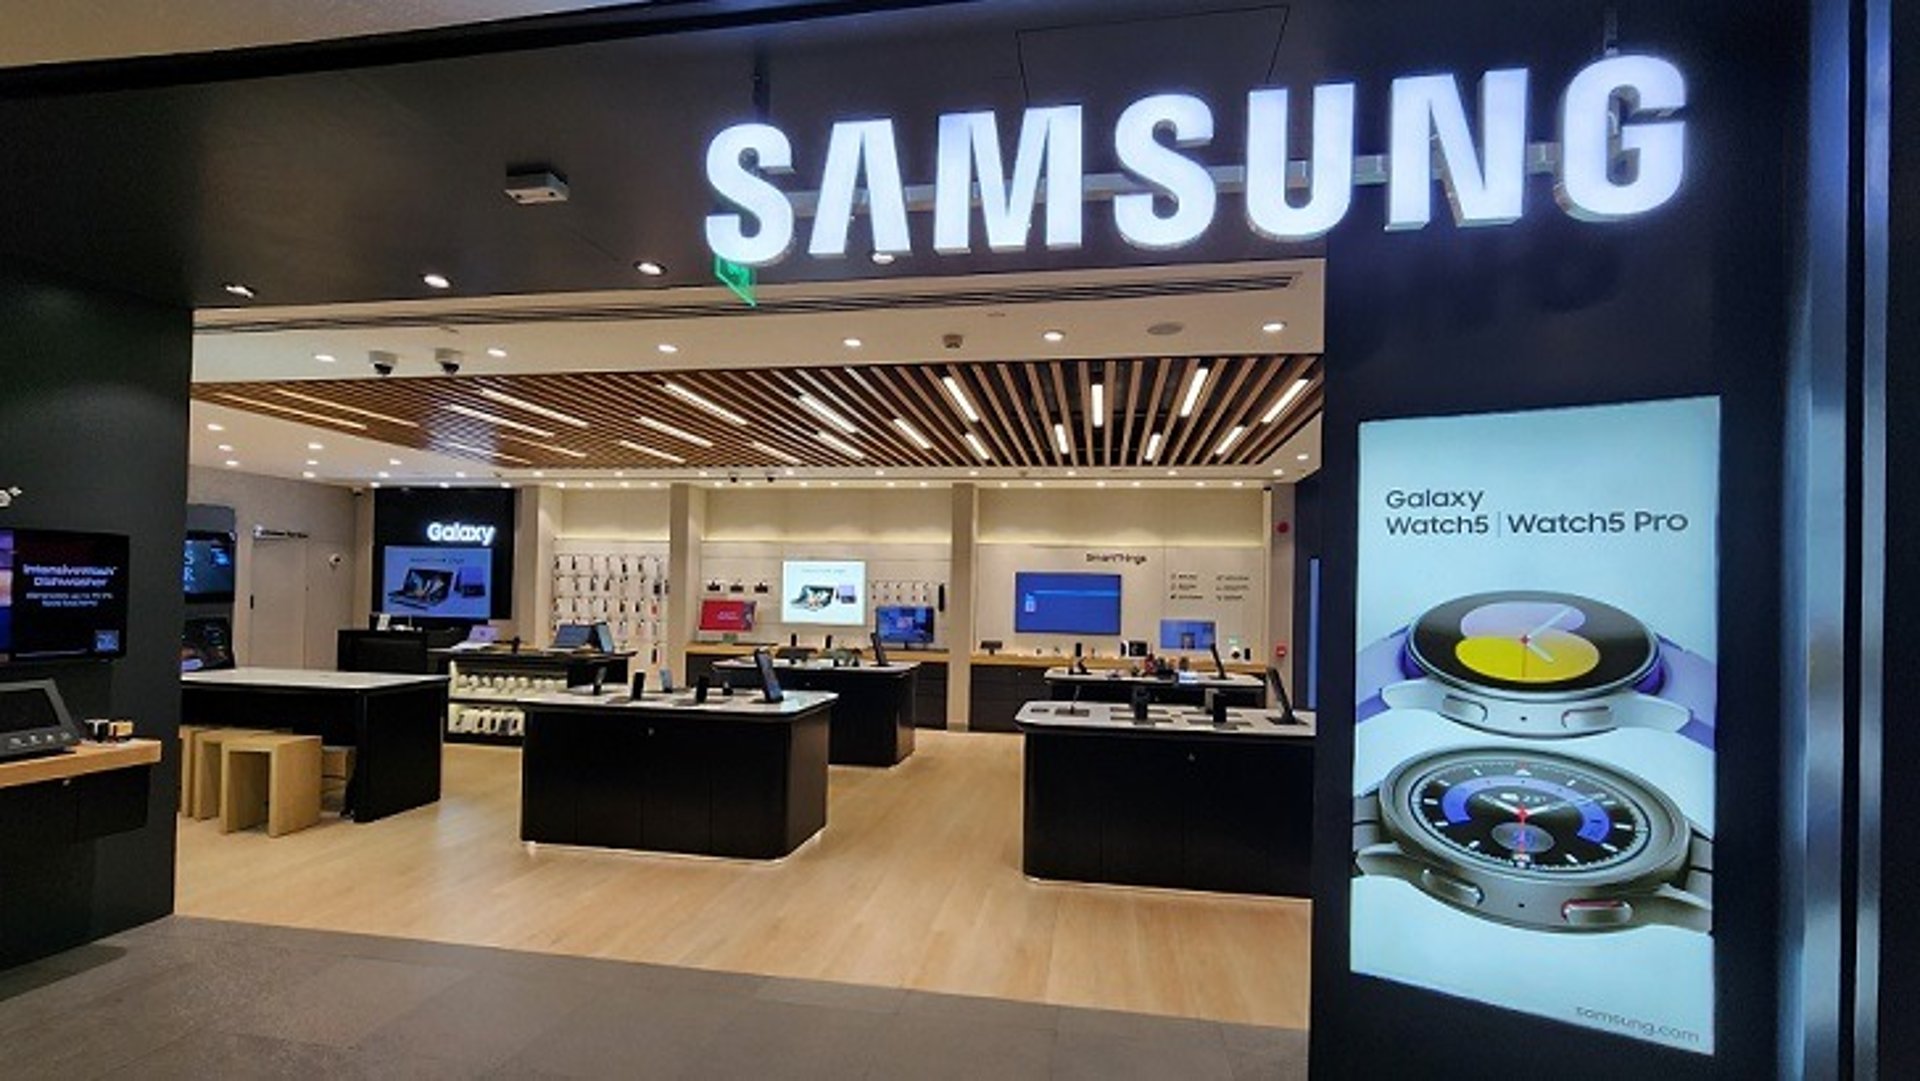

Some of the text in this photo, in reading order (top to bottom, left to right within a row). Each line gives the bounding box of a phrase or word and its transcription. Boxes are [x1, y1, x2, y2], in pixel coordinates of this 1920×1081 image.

[705, 54, 1687, 266] SAMSUNG
[1386, 489, 1484, 512] Galaxy
[427, 522, 496, 546] Galaxy
[1386, 511, 1689, 535] Watch5 Watch5 Pro
[1576, 1006, 1700, 1043] samsung.com
